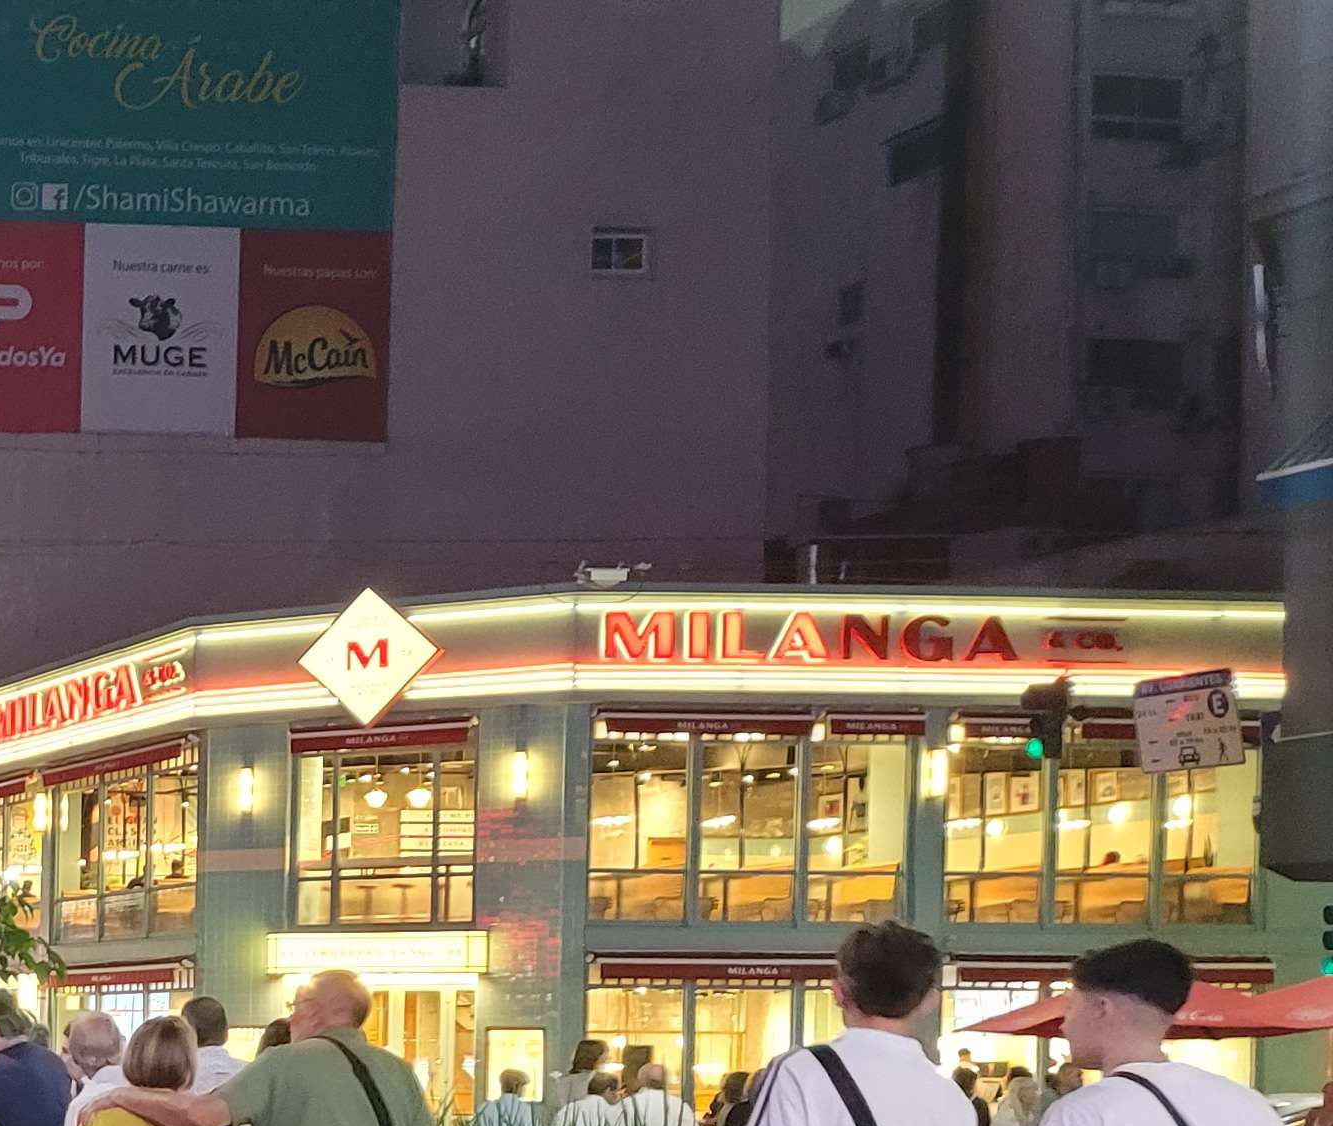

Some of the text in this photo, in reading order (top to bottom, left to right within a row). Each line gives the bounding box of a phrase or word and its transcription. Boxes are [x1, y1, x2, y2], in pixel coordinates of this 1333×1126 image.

[30, 15, 164, 62] Cocina
[114, 34, 305, 110] Árabe
[73, 183, 311, 217] /ShamiShawarma
[112, 259, 158, 273] Nuestra
[160, 261, 193, 273] carne
[112, 344, 208, 369] MUGE
[263, 336, 369, 377] McCain
[600, 610, 1020, 664] MILANGA
[347, 638, 389, 671] M
[677, 720, 730, 731] MILANGA
[846, 721, 897, 732] MILANGA
[981, 725, 1032, 735] MILANGA
[345, 734, 397, 746] MILANGA
[727, 966, 779, 976] MILANGA
